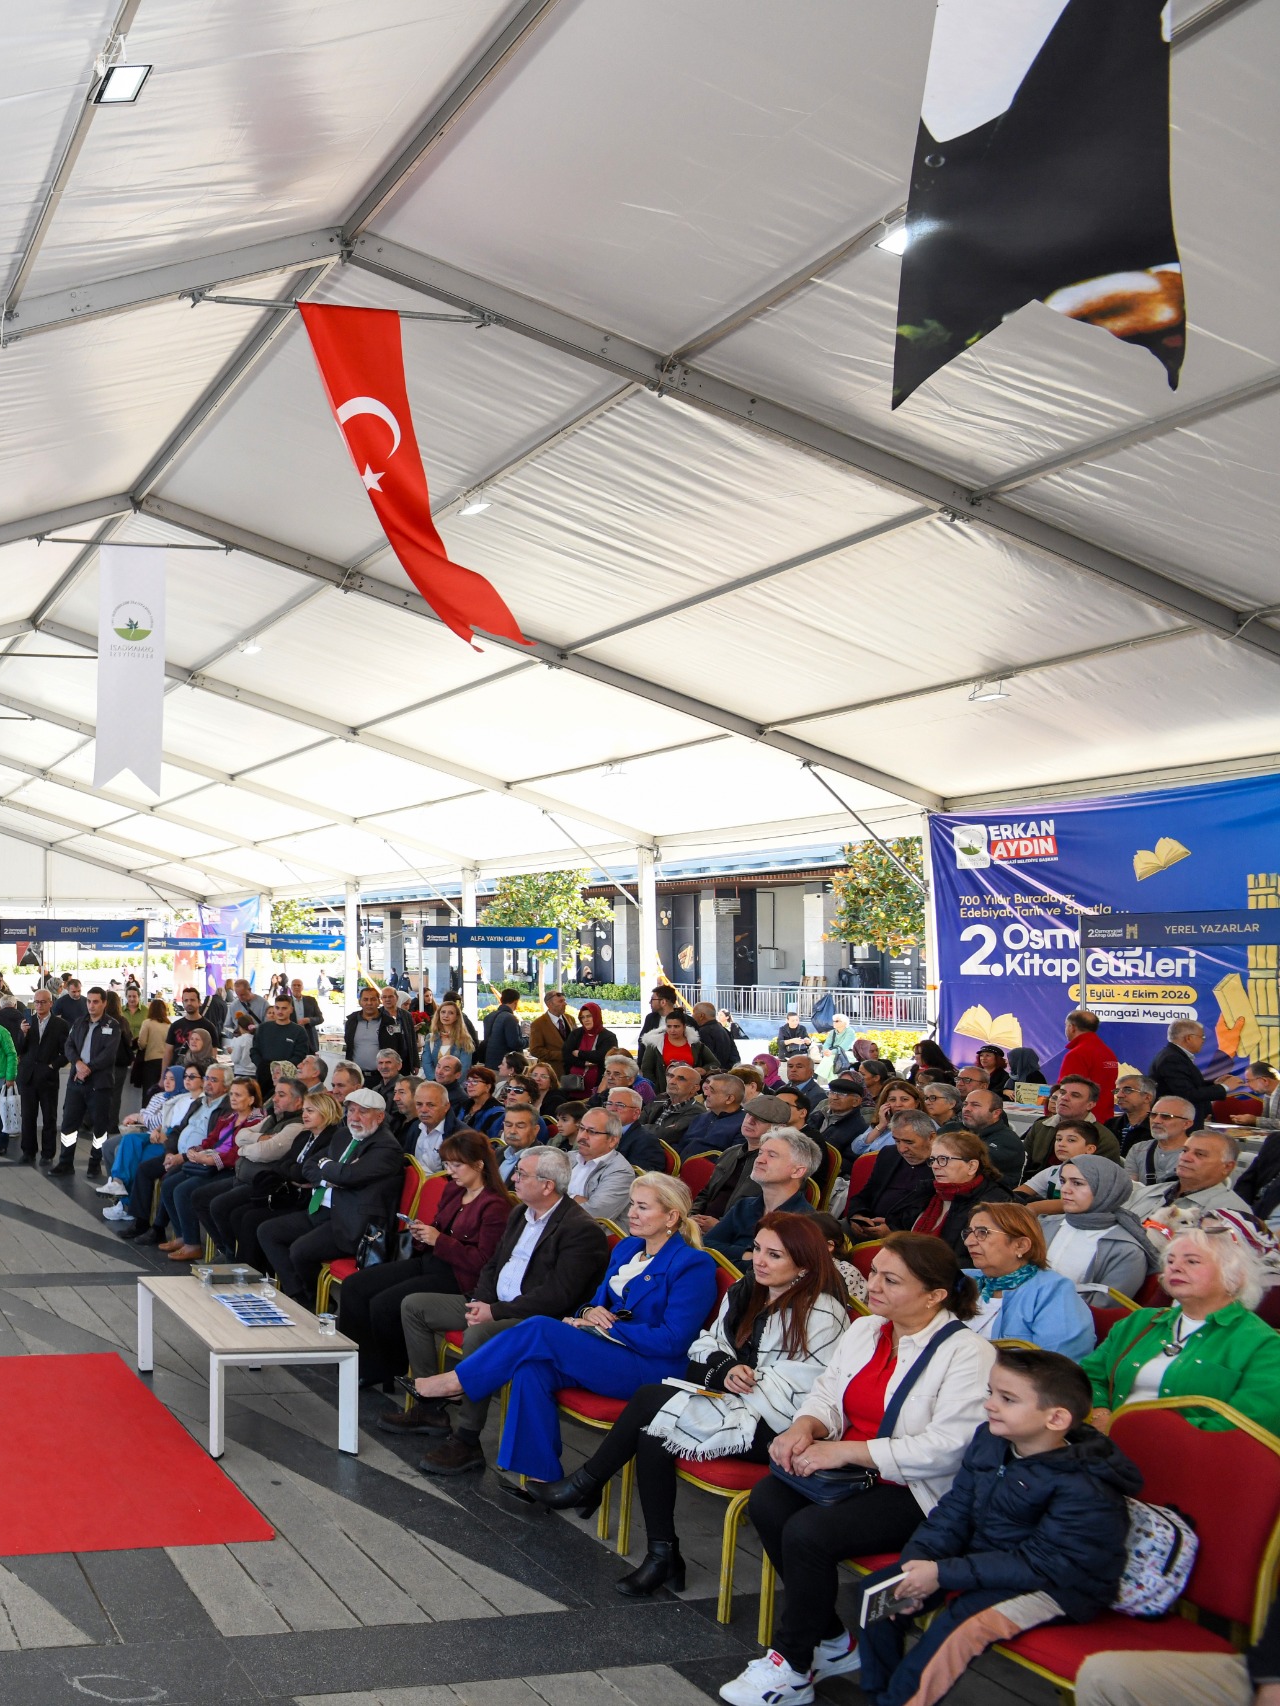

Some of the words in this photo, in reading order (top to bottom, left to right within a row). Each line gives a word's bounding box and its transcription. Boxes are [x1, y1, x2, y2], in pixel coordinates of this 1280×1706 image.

[988, 820, 1055, 841] ERKAN
[993, 838, 1055, 858] AYDIN
[959, 896, 980, 906] 700
[983, 895, 1011, 905] Yıldır
[960, 906, 1014, 919] Edebiyat,
[1015, 905, 1044, 918] Tarih
[1046, 908, 1061, 917] ve
[1164, 925, 1197, 935] YEREL
[1200, 923, 1260, 934] YAZARLAR
[959, 924, 1004, 977] 2.
[1005, 952, 1081, 984] Kitap
[1085, 949, 1197, 978] Günleri
[1090, 989, 1116, 1001] Eylül
[1123, 990, 1130, 999] 4
[1132, 990, 1159, 999] Ekim
[1161, 990, 1190, 999] 2026
[1142, 1008, 1190, 1022] Meydanı
